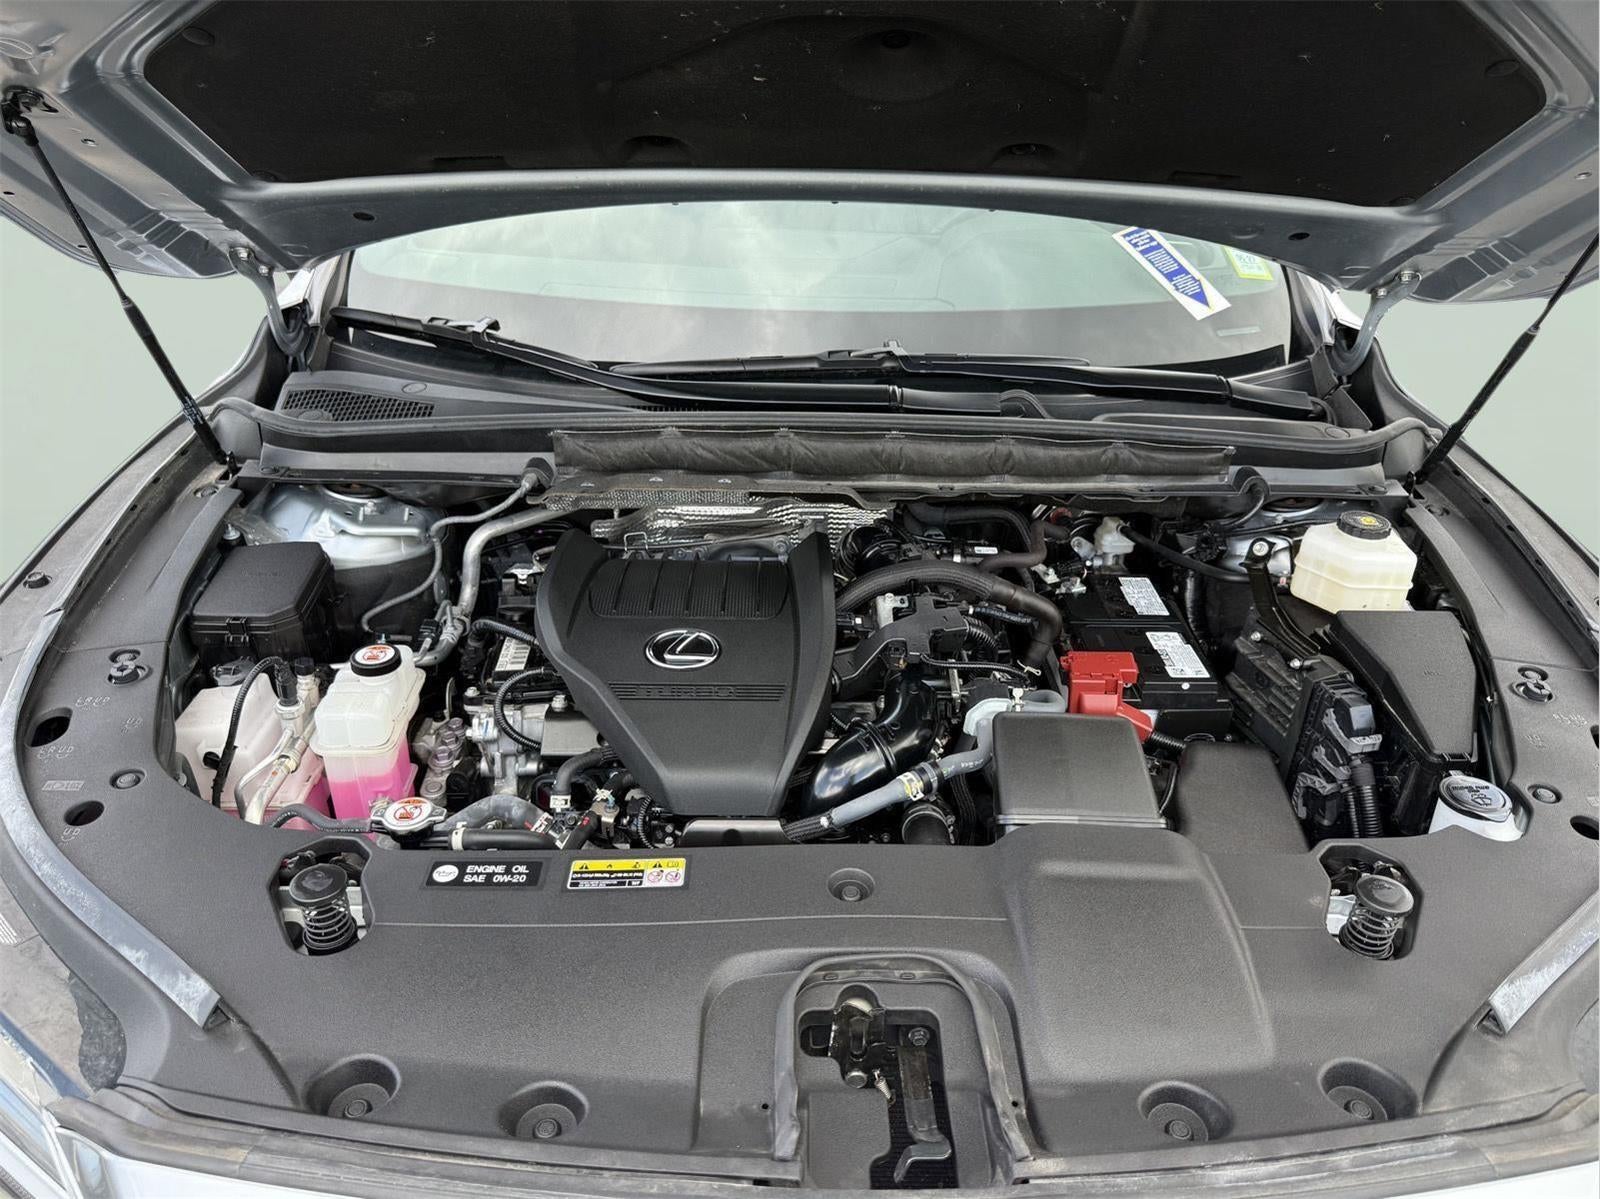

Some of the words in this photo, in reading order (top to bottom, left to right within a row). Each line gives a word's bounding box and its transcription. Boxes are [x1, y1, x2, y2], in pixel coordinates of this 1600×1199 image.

[466, 865, 507, 873] ENGINE
[511, 865, 529, 874] OIL
[463, 874, 486, 883] SAE
[493, 874, 527, 883] 0W-20
